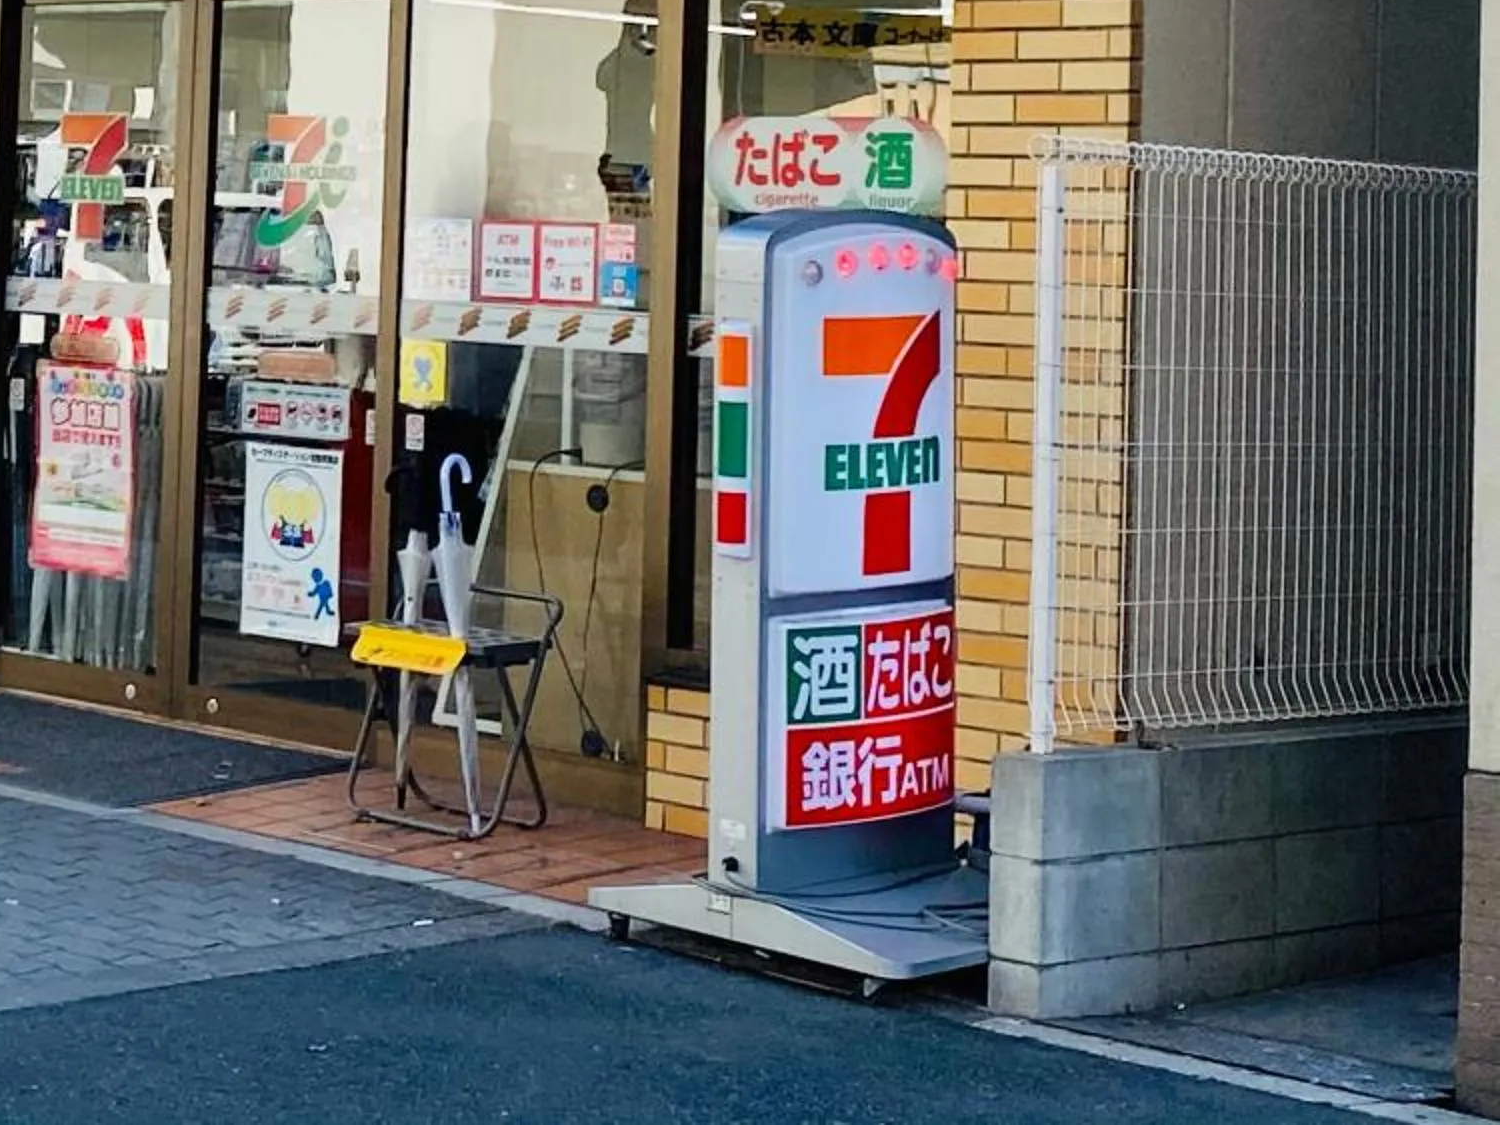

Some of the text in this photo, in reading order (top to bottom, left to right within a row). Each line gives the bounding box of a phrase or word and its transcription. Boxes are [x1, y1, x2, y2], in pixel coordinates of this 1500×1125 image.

[734, 131, 914, 189] たばこ 酒
[792, 620, 952, 720] 酒 たばこ
